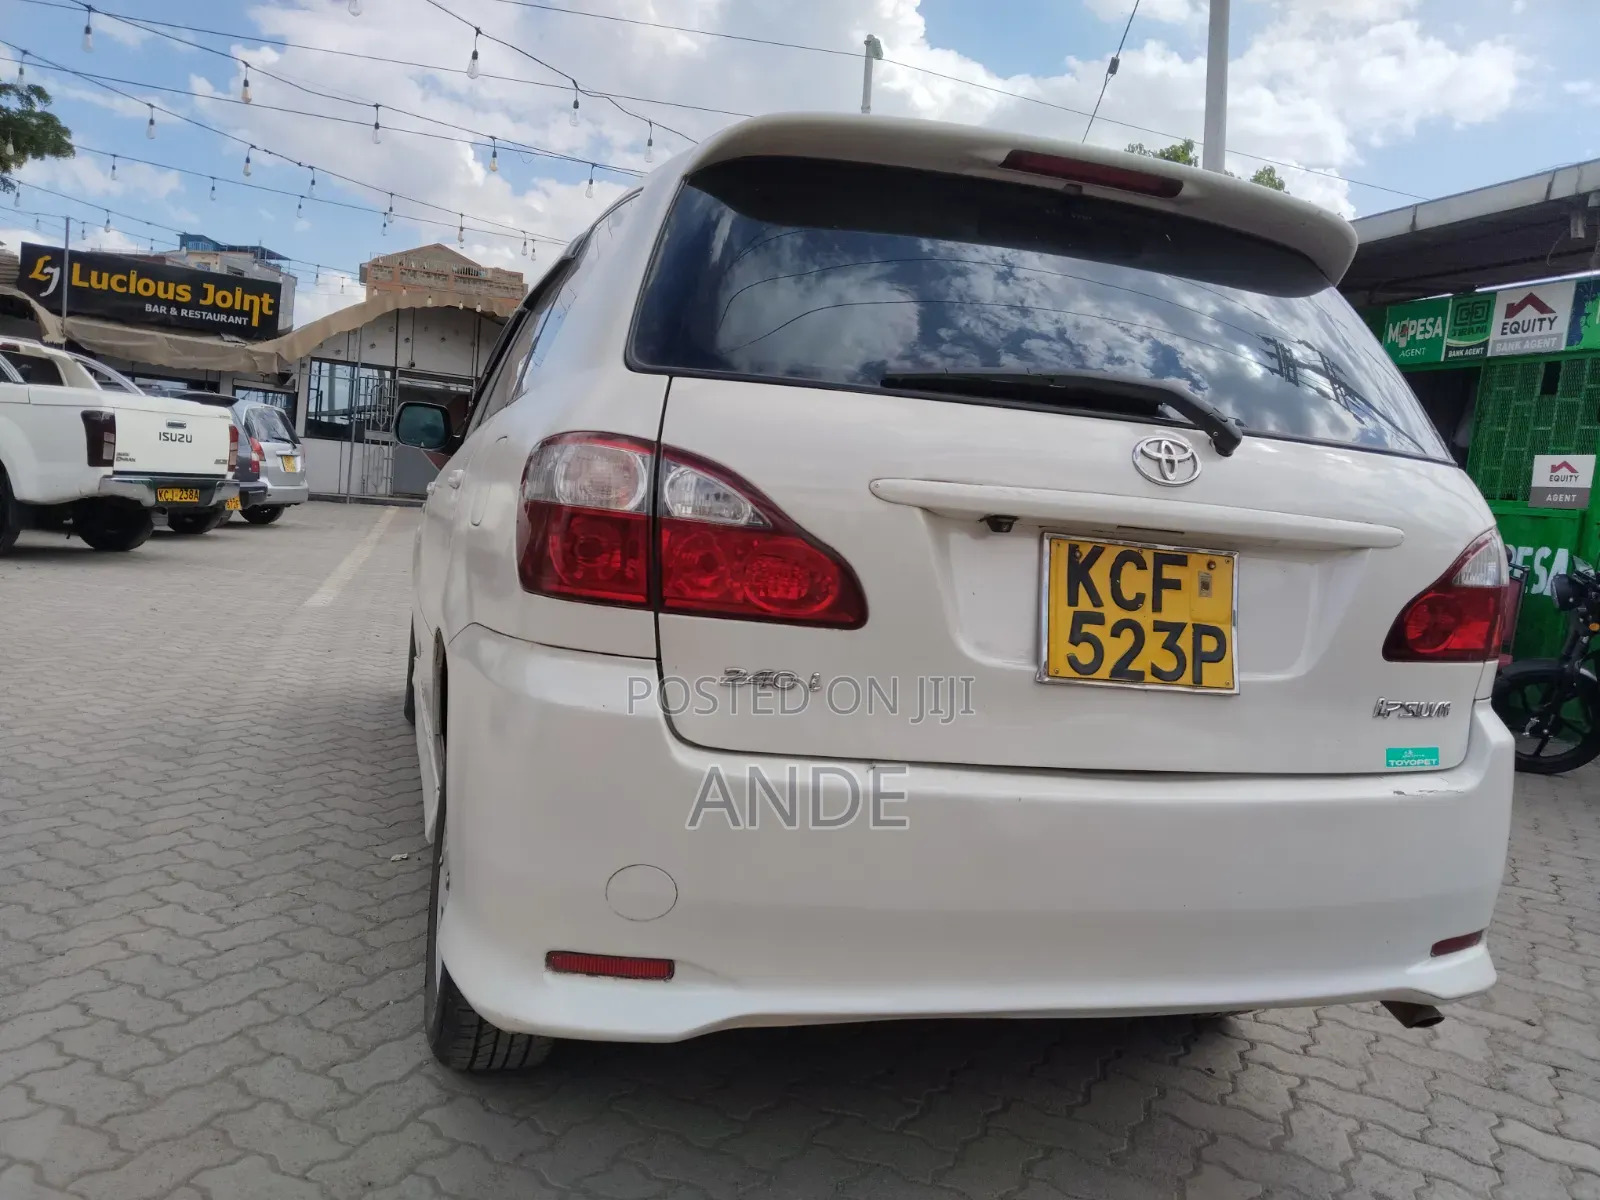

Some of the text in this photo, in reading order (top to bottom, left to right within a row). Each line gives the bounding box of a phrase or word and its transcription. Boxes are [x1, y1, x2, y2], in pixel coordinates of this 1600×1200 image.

[71, 262, 275, 327] Lucious Joint
[145, 303, 249, 326] BAR & RESTAURANT
[1500, 316, 1558, 336] EQUITY
[1496, 337, 1558, 352] BANK AGENT
[1399, 347, 1426, 358] AGENT
[1448, 347, 1485, 358] BANK AGENT
[159, 431, 193, 444] ISUZU
[1549, 475, 1580, 483] EQUITY
[158, 489, 199, 501] KCJ 238A
[1546, 493, 1577, 502] AGENT
[1067, 543, 1188, 613] KCF
[1067, 610, 1227, 685] 523P
[1388, 758, 1438, 767] TOYOPET
